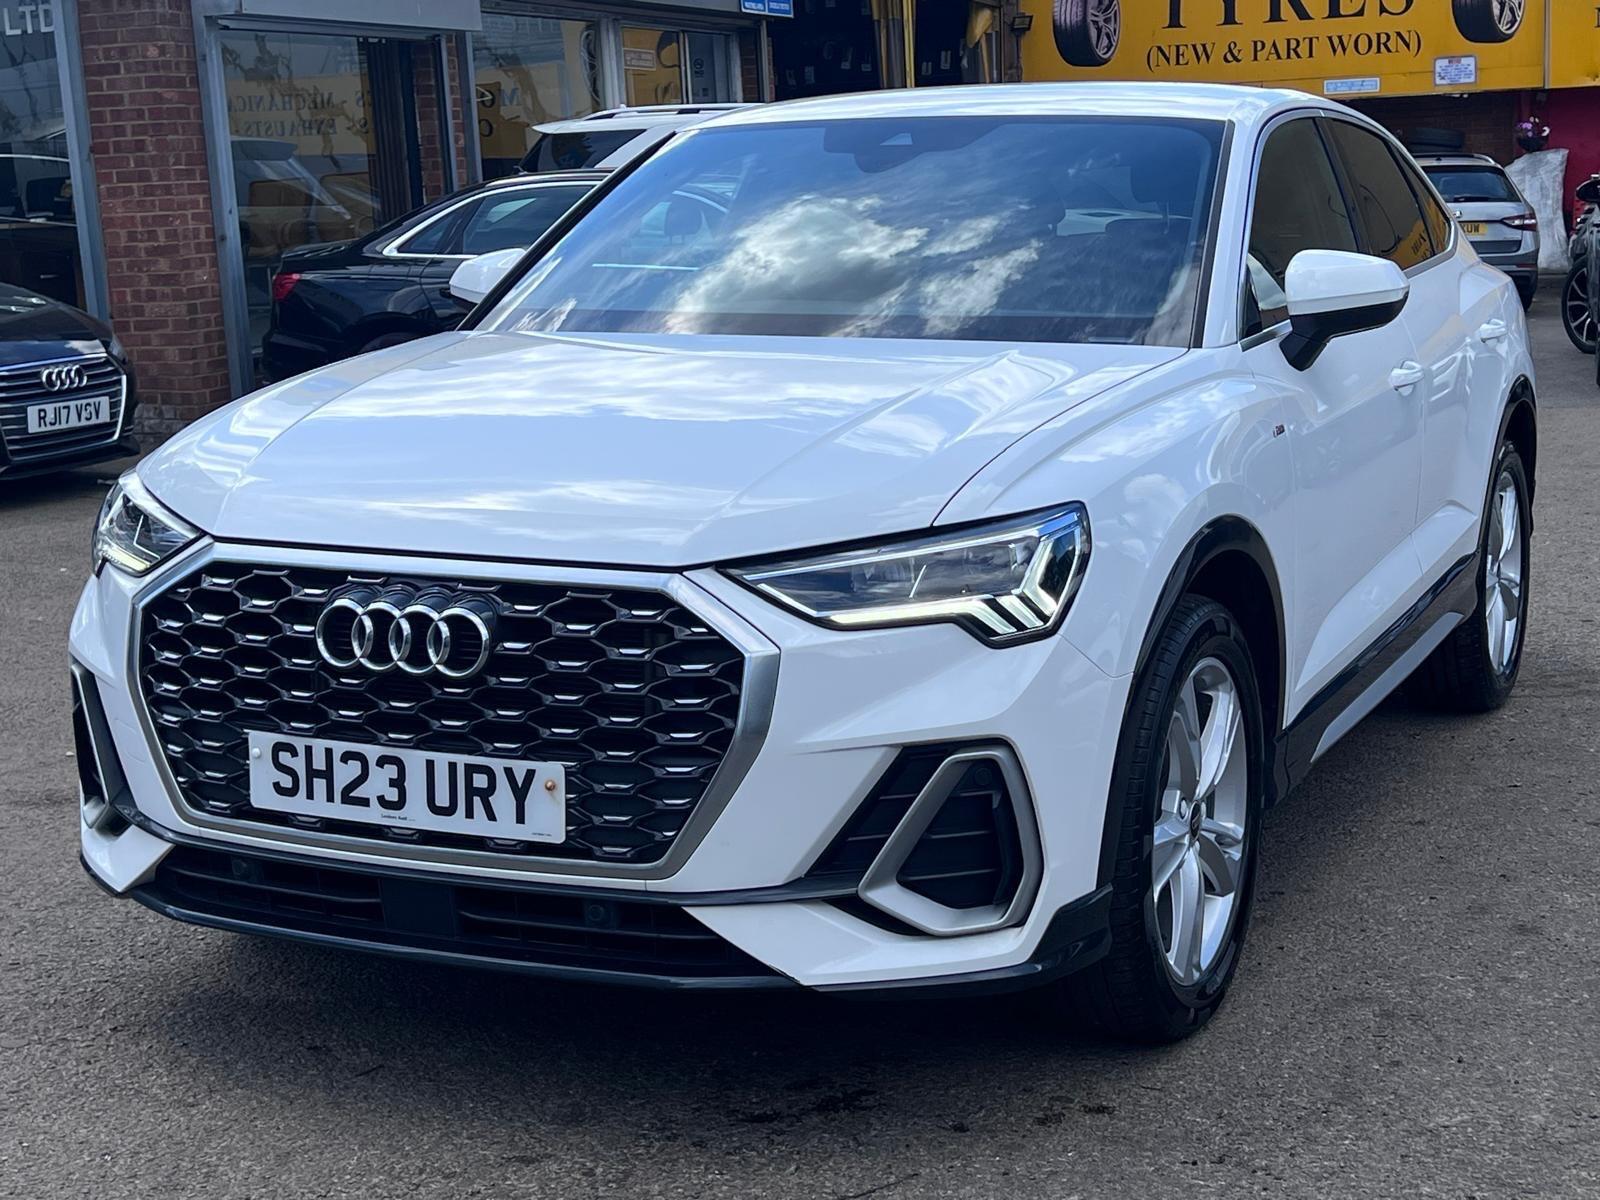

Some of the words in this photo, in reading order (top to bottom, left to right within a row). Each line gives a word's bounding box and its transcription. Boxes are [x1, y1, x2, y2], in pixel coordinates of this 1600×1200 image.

[3, 5, 55, 36] LTD
[1146, 43, 1216, 73] (NEW
[1222, 40, 1243, 64] &
[1250, 36, 1319, 62] PART
[1327, 29, 1422, 57] WORN)
[38, 405, 71, 428] RJ17
[75, 401, 101, 423] VSV
[271, 741, 407, 811] SH23
[425, 759, 537, 825] URY
